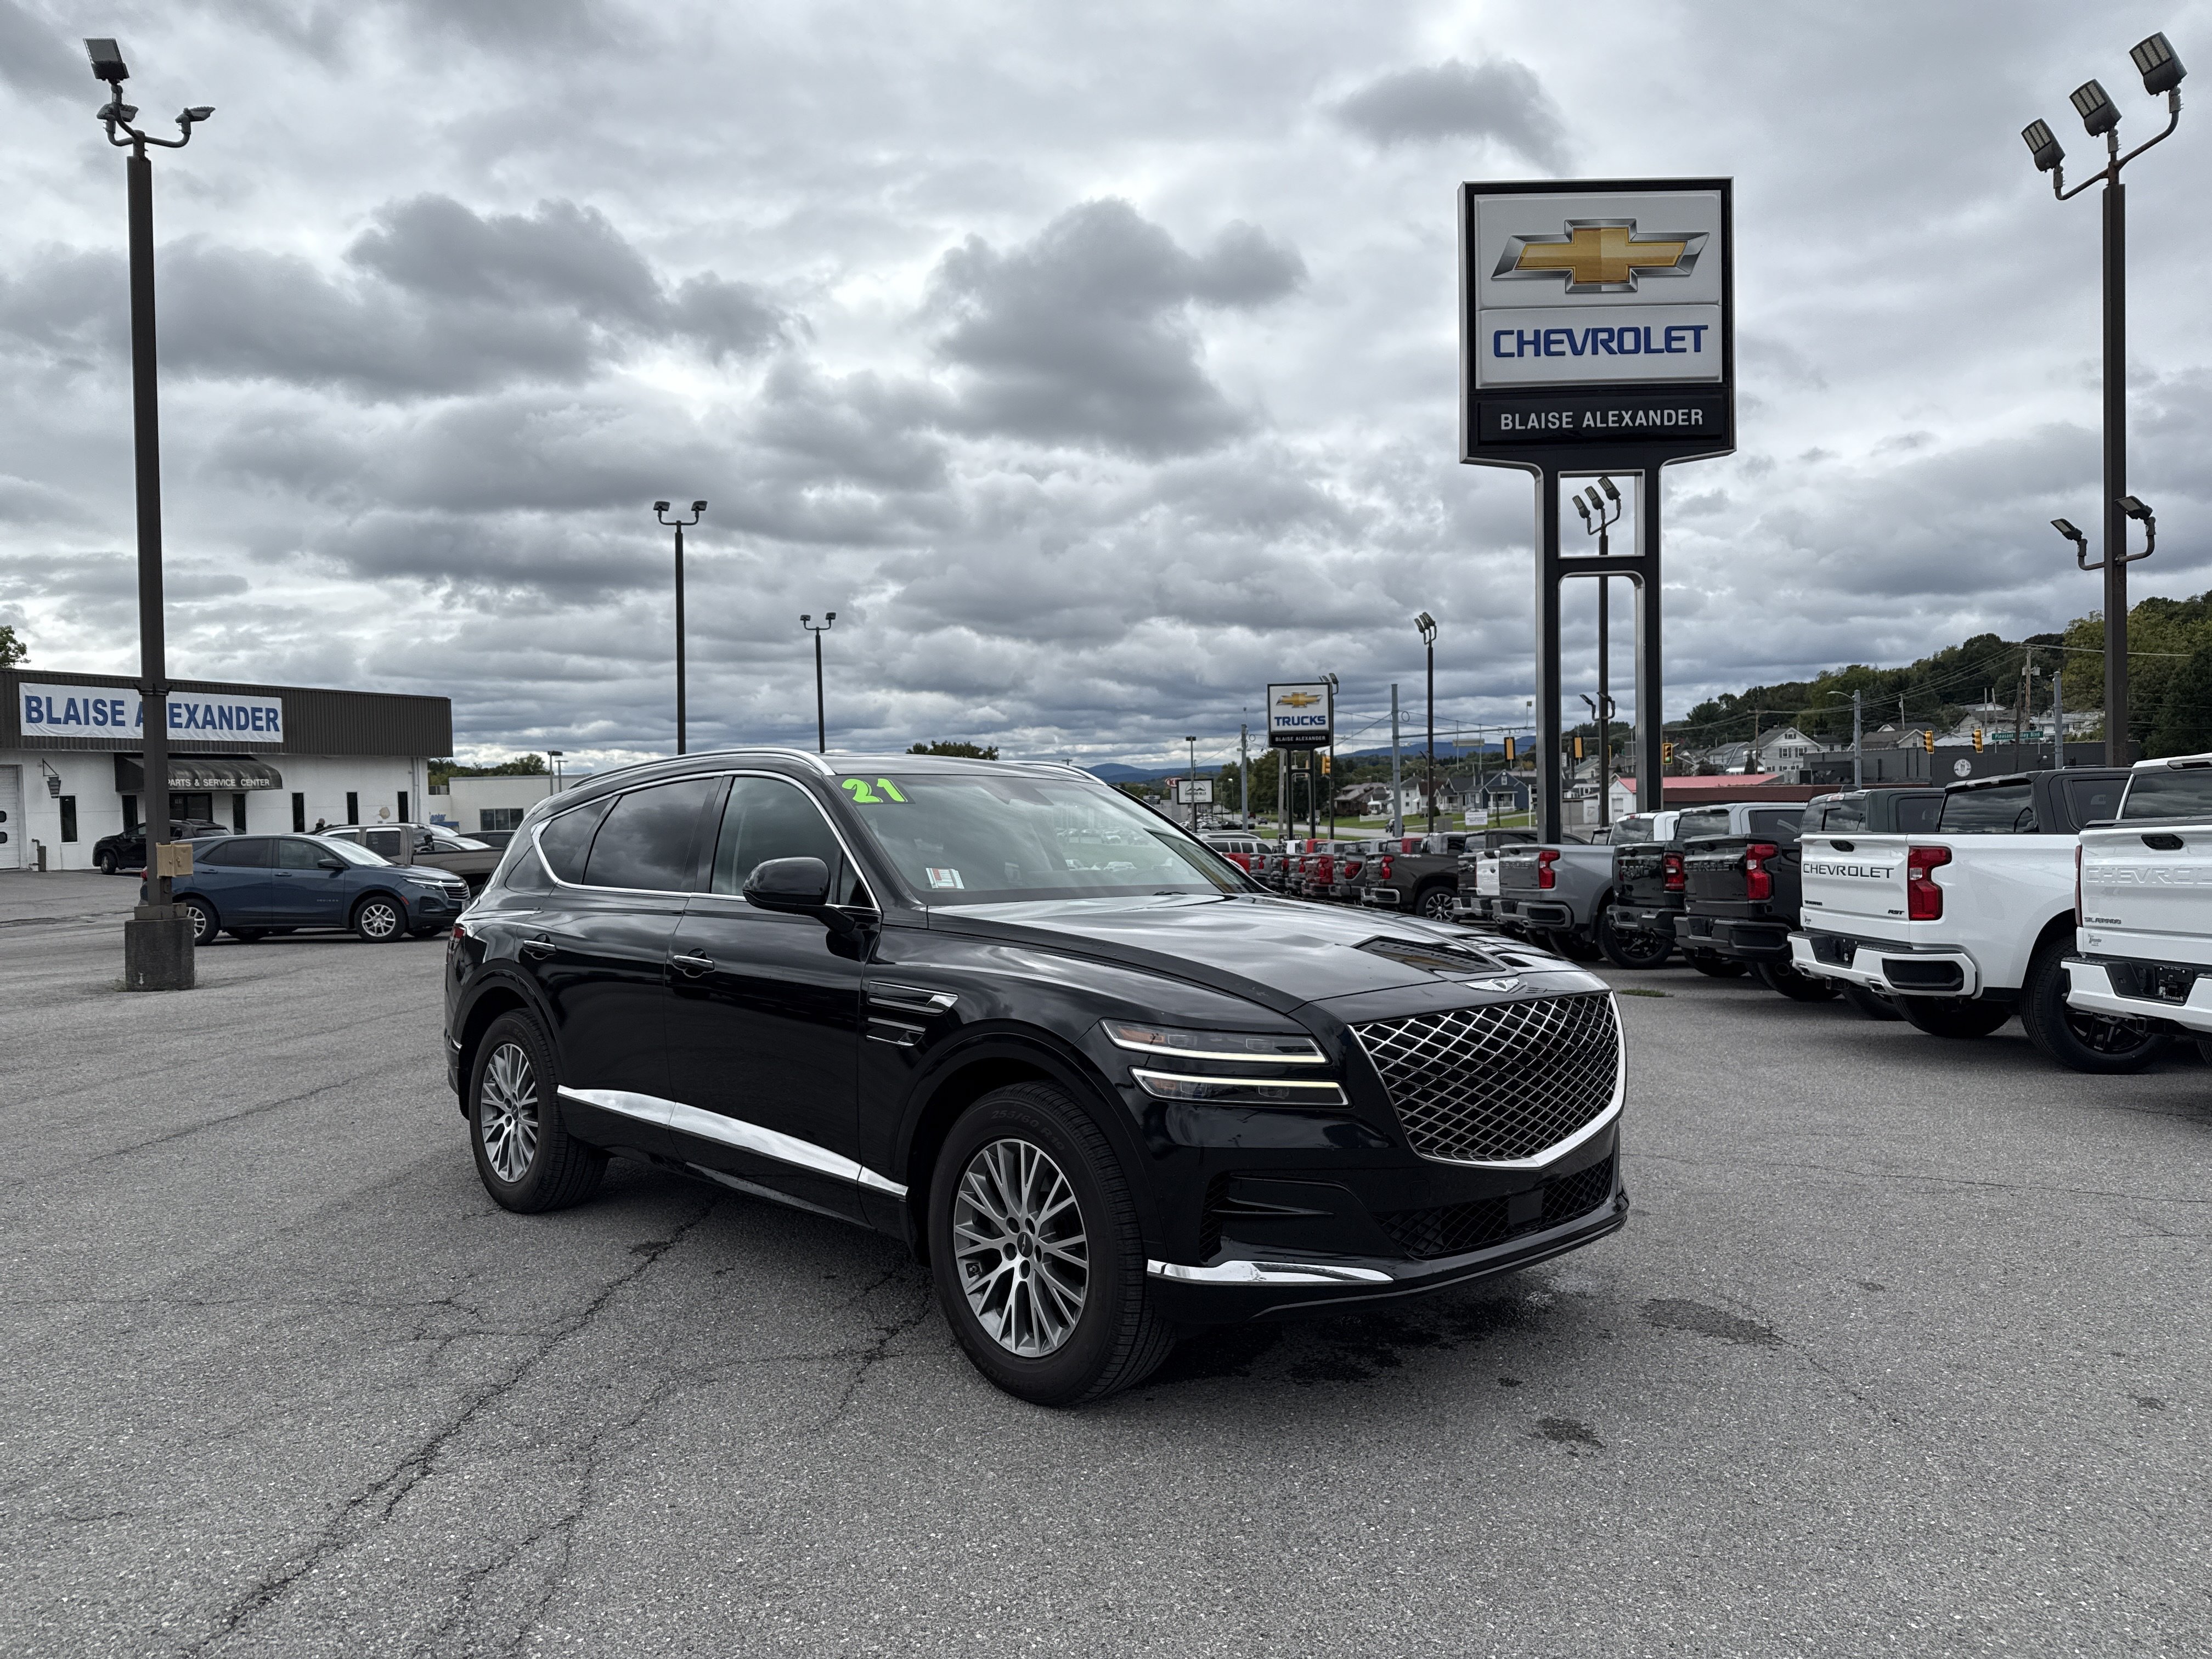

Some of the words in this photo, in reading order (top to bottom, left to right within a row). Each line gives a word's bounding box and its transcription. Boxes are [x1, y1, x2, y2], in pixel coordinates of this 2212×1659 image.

[1493, 325, 1708, 357] CHEVROLET
[1500, 411, 1573, 430] BLAISE
[1582, 409, 1703, 427] ALEXANDER
[25, 695, 126, 726] BLAISE
[134, 701, 280, 732] EXANDER
[1274, 715, 1326, 726] TRUCKS
[168, 778, 191, 787] ARTS
[194, 778, 200, 787] &
[203, 778, 236, 787] SERVICE
[842, 778, 908, 804] 21
[1803, 863, 1894, 878] CHEVROLET
[990, 1110, 1040, 1128] 255/60
